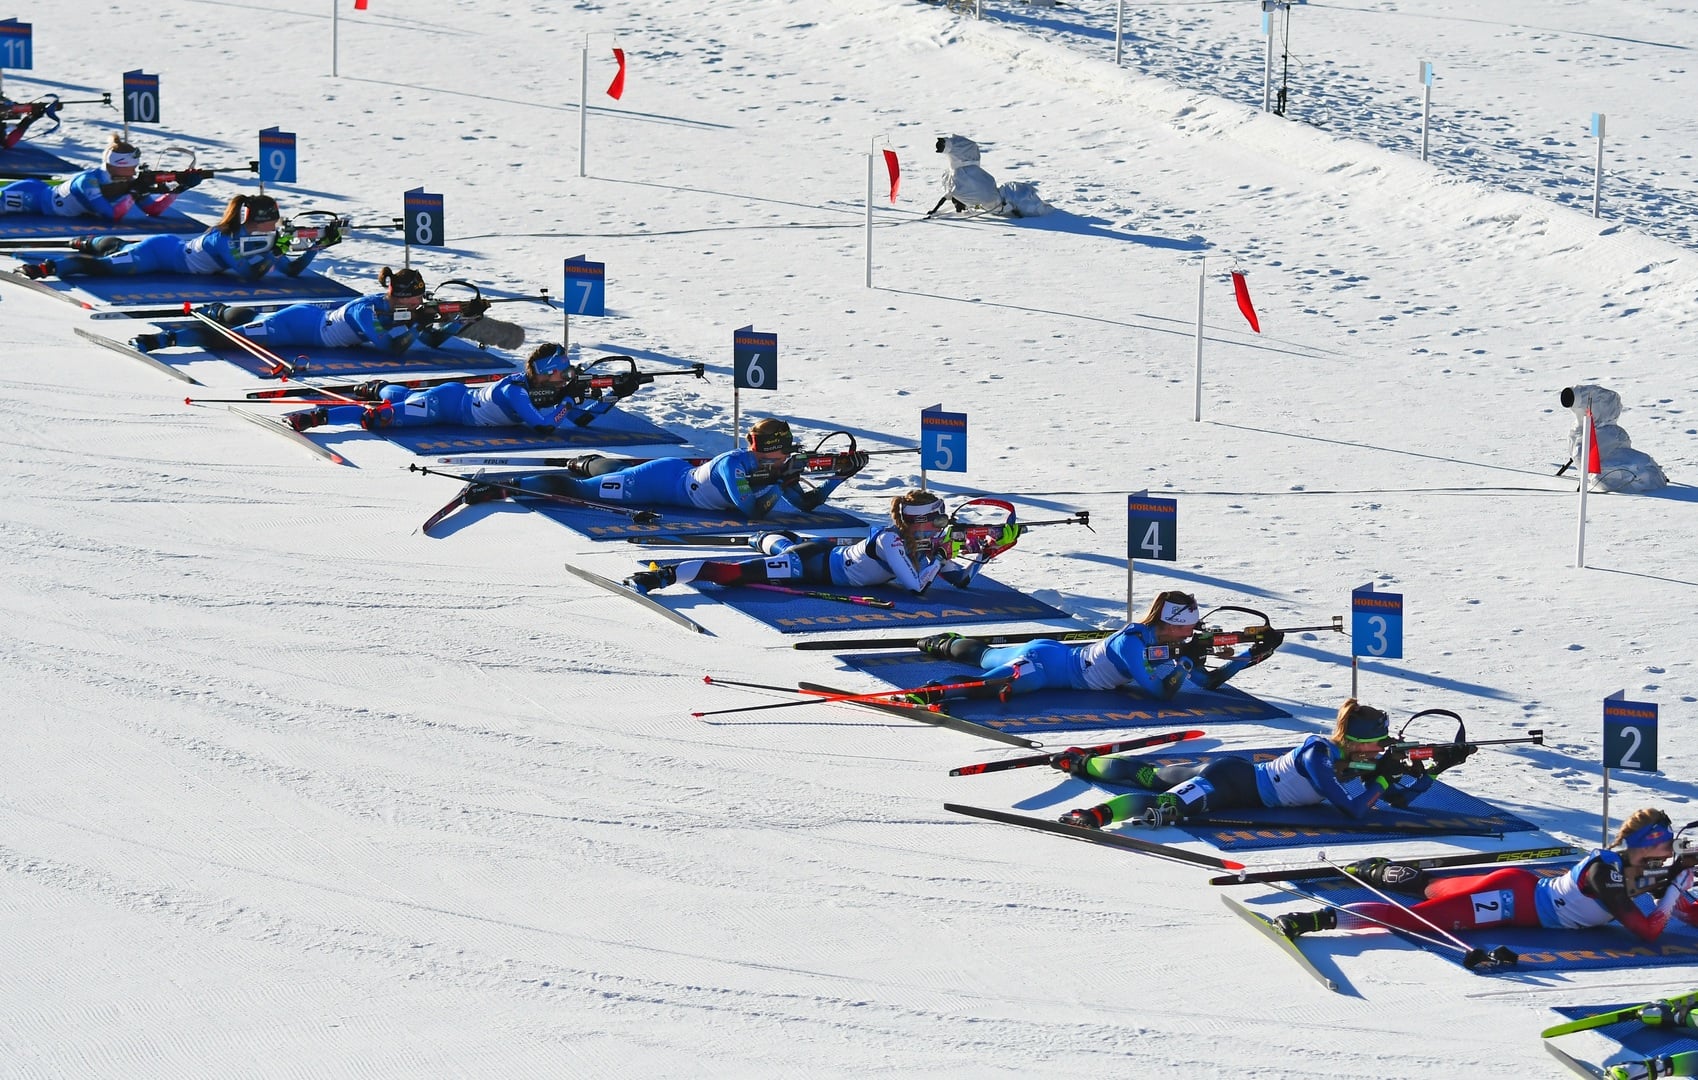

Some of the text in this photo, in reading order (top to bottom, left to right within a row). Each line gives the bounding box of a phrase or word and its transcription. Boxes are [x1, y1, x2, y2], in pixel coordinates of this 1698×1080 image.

[4, 40, 25, 67] 11
[128, 91, 155, 121] 10
[269, 150, 286, 180] 9
[6, 193, 22, 208] 10
[415, 212, 433, 244] 8
[576, 281, 592, 313] 7
[746, 353, 765, 387] 6
[406, 400, 425, 409] 7
[934, 434, 953, 469] 5
[601, 482, 621, 490] 6
[1141, 521, 1163, 558] 4
[767, 560, 788, 569] 5
[1366, 615, 1387, 656] 3
[1620, 726, 1641, 768] 2
[1177, 784, 1196, 796] 3
[1496, 849, 1561, 862] FISCHER
[1475, 901, 1499, 913] 2
[1554, 899, 1566, 908] 2
